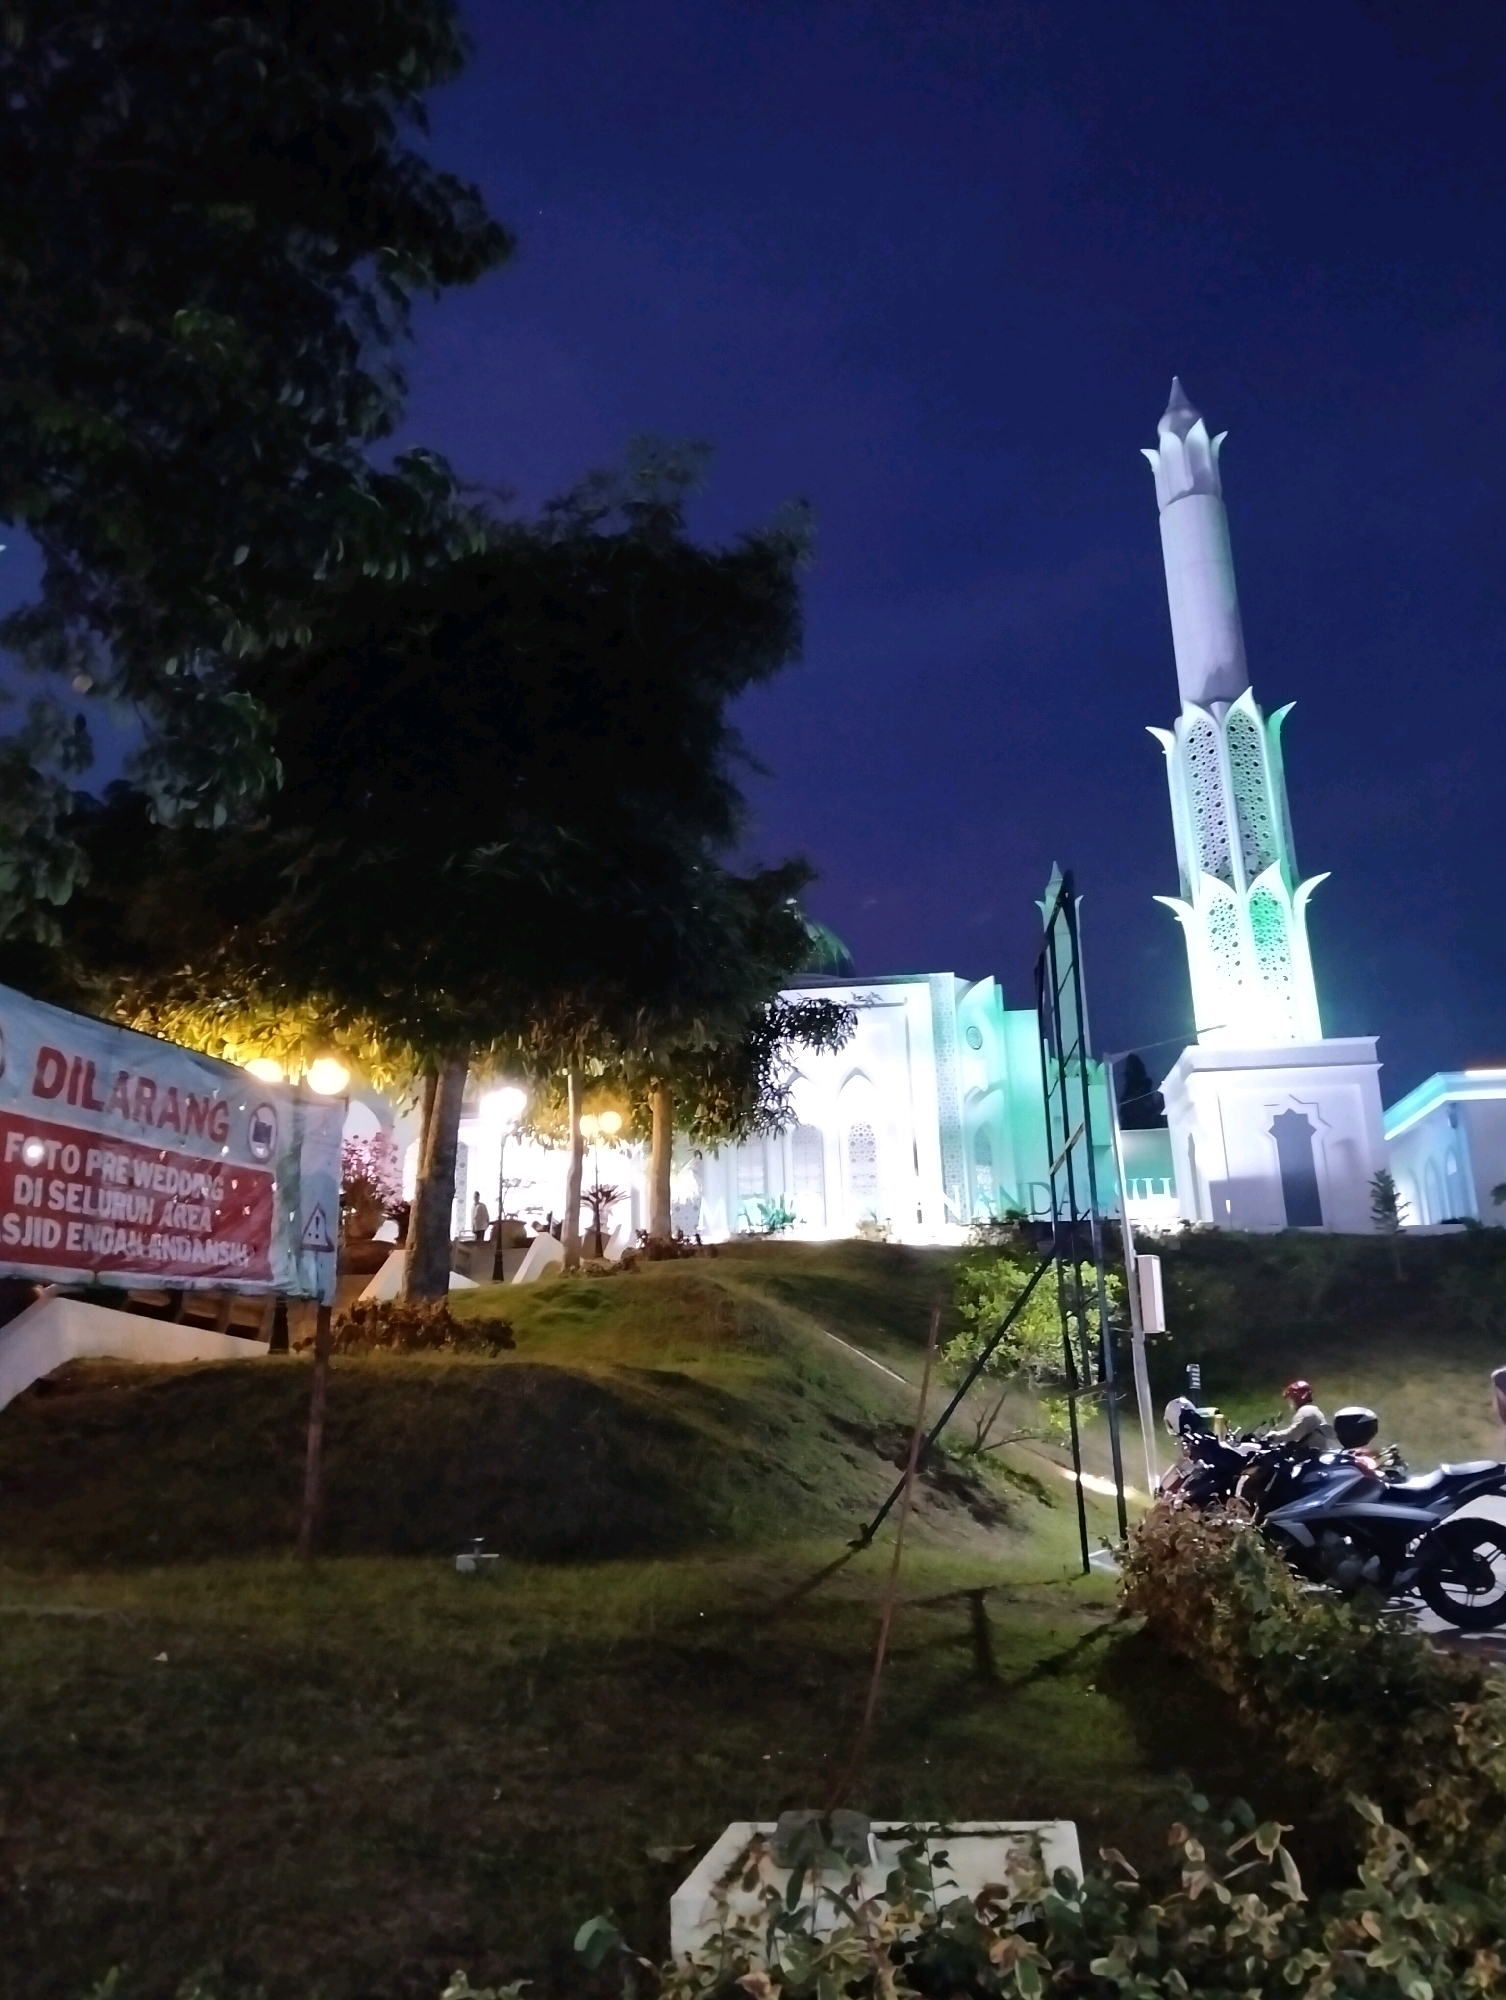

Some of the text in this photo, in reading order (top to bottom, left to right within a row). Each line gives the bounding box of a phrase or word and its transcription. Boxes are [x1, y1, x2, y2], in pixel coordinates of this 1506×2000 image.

[32, 1046, 230, 1144] DILARANG
[4, 1131, 81, 1176] FOTO
[13, 1174, 213, 1233] DI SELURUH AREA
[0, 1212, 62, 1250] SJID
